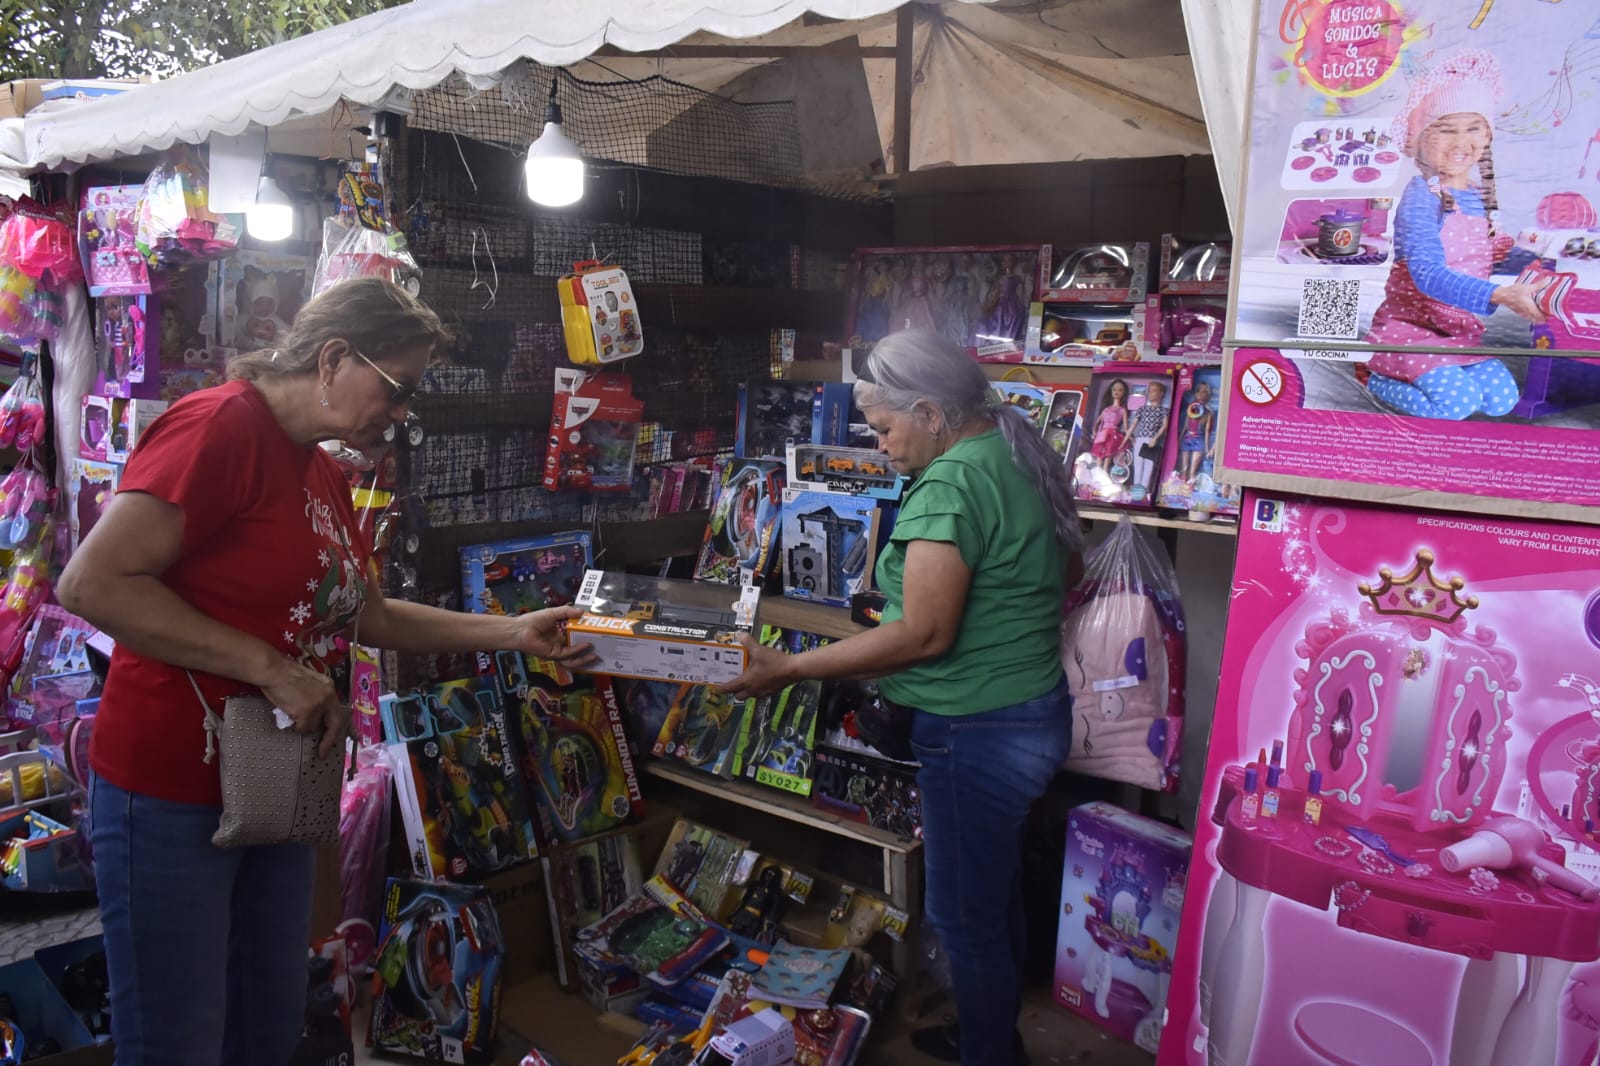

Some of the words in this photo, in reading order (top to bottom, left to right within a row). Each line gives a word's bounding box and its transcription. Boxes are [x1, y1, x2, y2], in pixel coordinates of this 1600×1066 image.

[1325, 23, 1381, 43] SONIDOS
[1345, 43, 1358, 59] &
[1322, 57, 1378, 79] LUCES
[1316, 350, 1349, 359] COCINA!
[1241, 415, 1284, 426] Advertencia:
[1239, 444, 1270, 454] Warning:
[1416, 517, 1486, 532] SPECIFICATIONS
[1487, 525, 1531, 538] COLOURS
[1531, 532, 1551, 540] AND
[1498, 537, 1521, 547] VARY
[1523, 540, 1550, 551] FROM
[575, 614, 642, 631] TRUCK
[643, 624, 708, 636] CONSTRUCTION
[602, 685, 622, 719] RAIL
[610, 722, 642, 802] LUMINOUS
[759, 771, 802, 791] SY027
